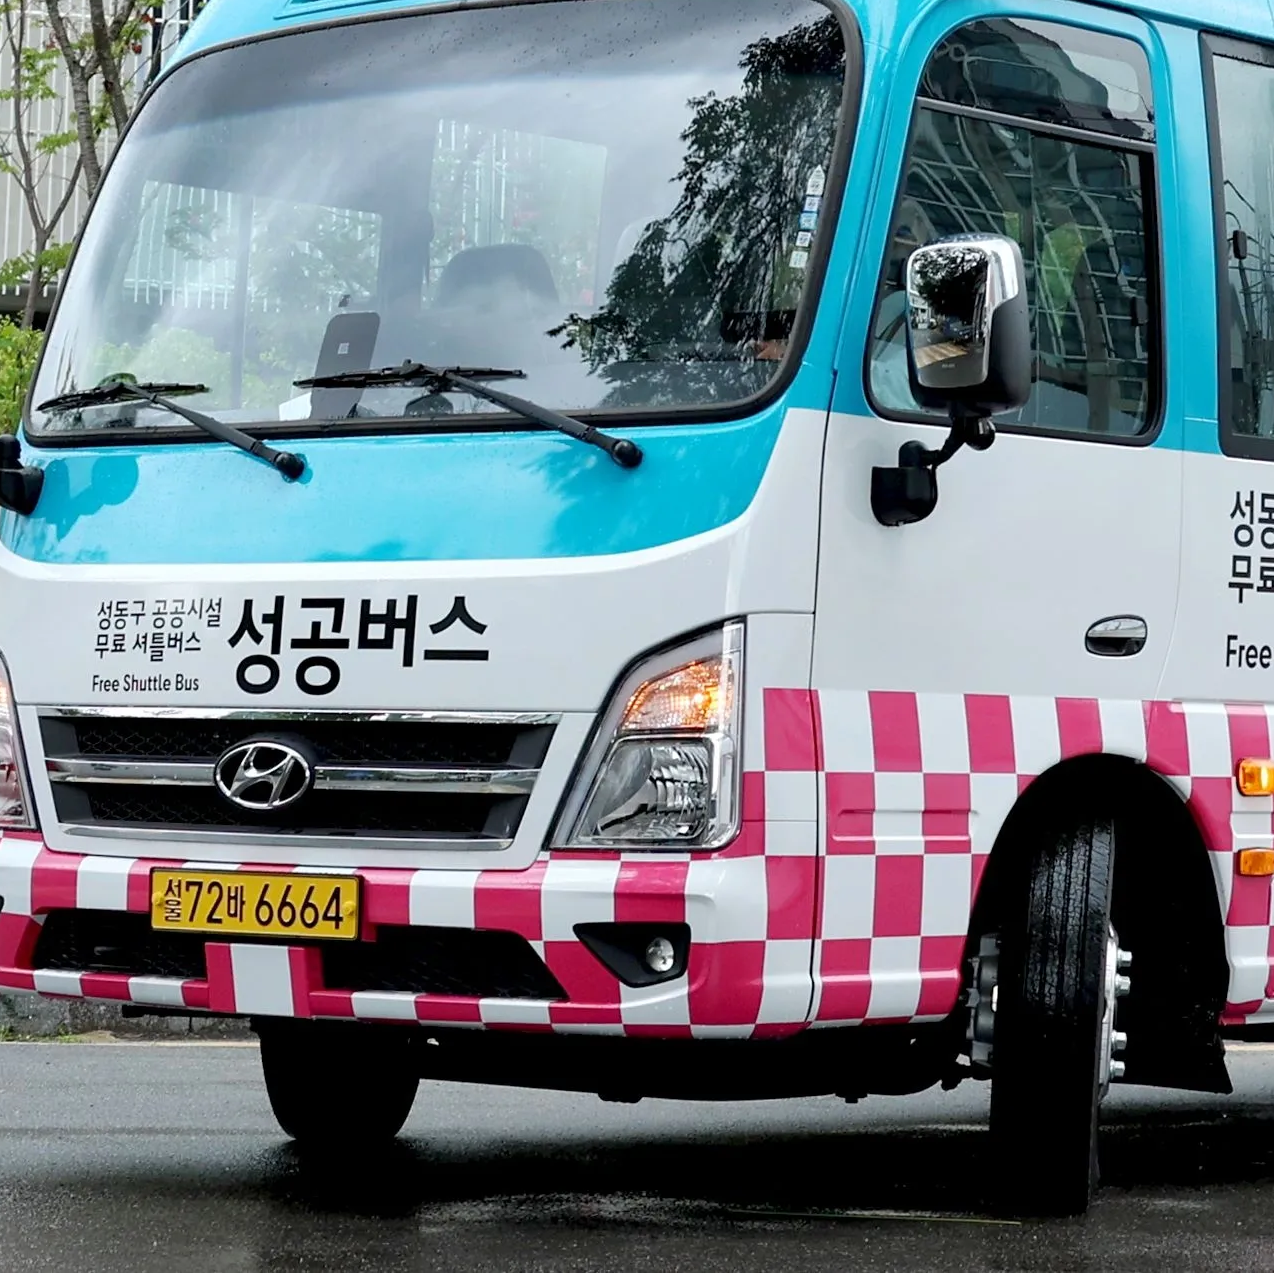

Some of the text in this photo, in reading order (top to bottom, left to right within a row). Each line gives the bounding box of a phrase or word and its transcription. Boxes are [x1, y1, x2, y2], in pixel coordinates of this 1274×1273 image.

[97, 597, 222, 630] 성동구 공공시설
[94, 631, 202, 662] 무료 셔틀버스
[227, 594, 490, 696] 성공버스
[1225, 634, 1272, 669] Free
[92, 673, 199, 692] Free Shuttle Bus
[255, 883, 343, 930] 6664
